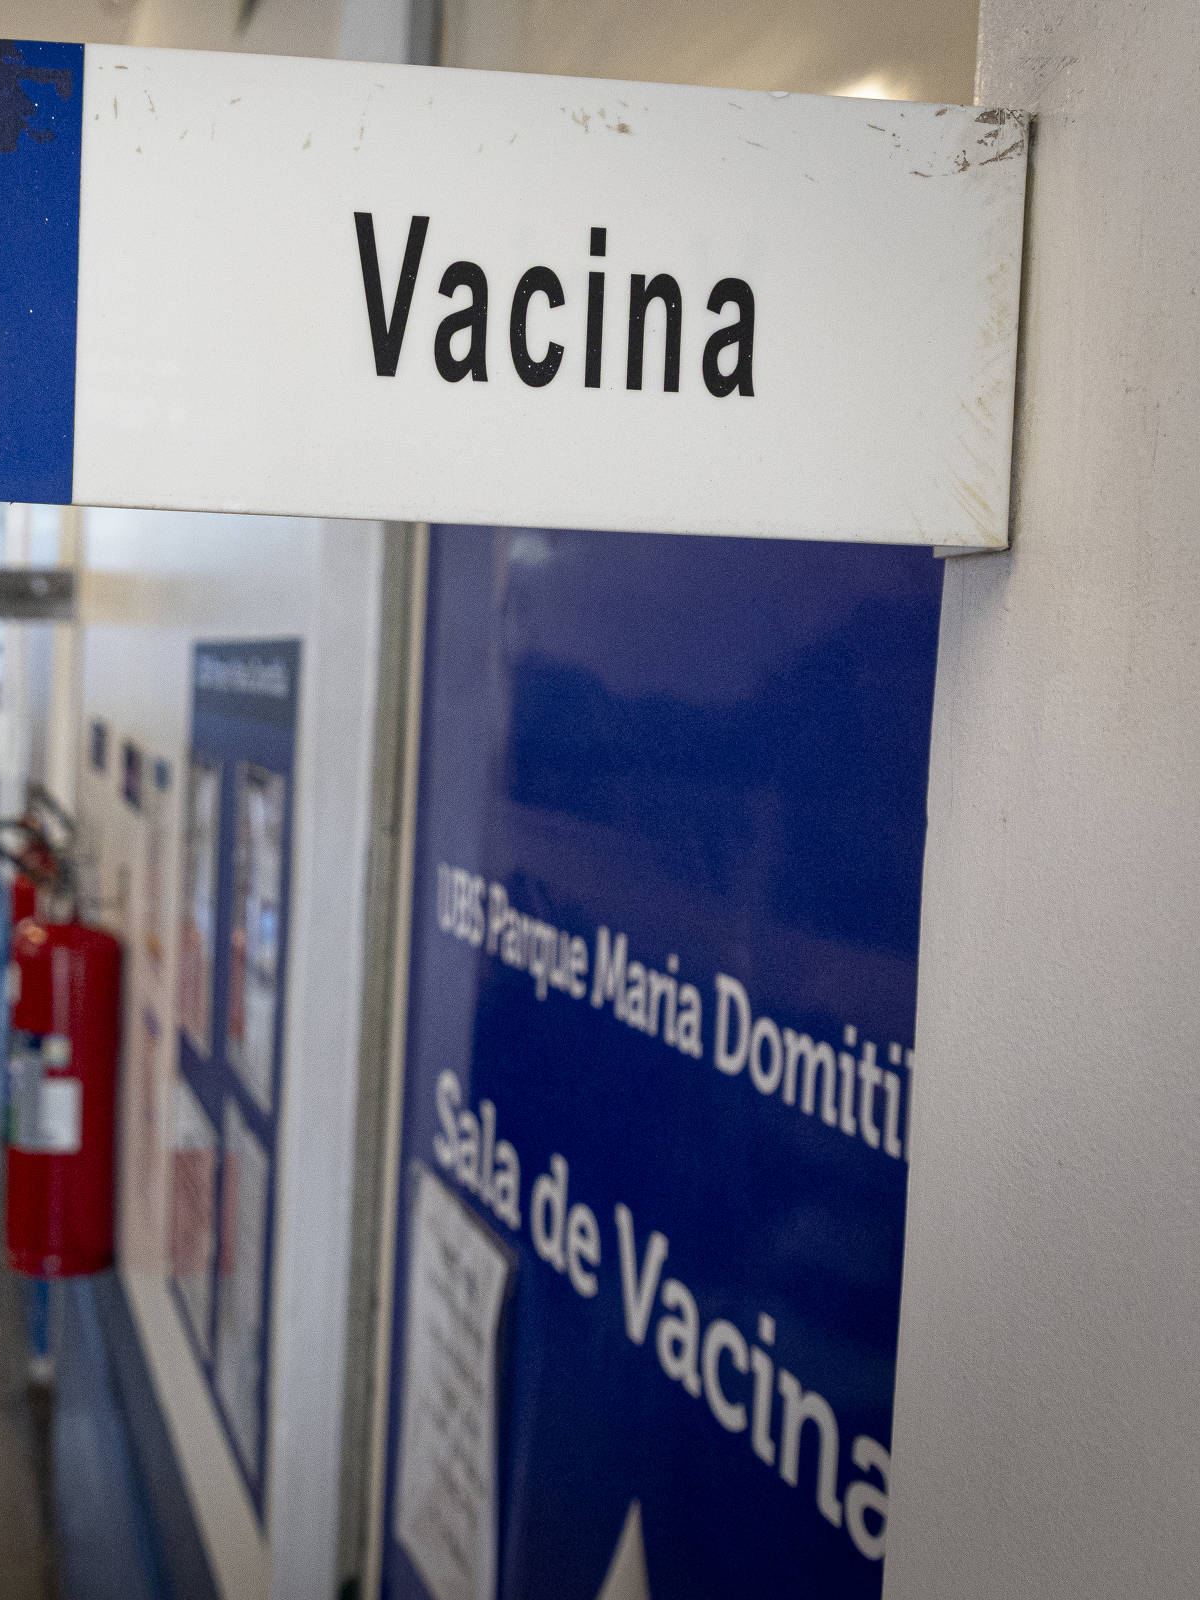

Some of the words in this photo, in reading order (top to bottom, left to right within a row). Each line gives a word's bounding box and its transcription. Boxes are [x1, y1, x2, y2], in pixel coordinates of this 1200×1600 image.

[353, 211, 756, 398] Vacina
[437, 862, 487, 946] UBS
[487, 884, 590, 1000] Parque
[591, 926, 702, 1060] Maria
[434, 1069, 520, 1231] Sala
[531, 1154, 601, 1298] de
[616, 1204, 891, 1561] Vacina
